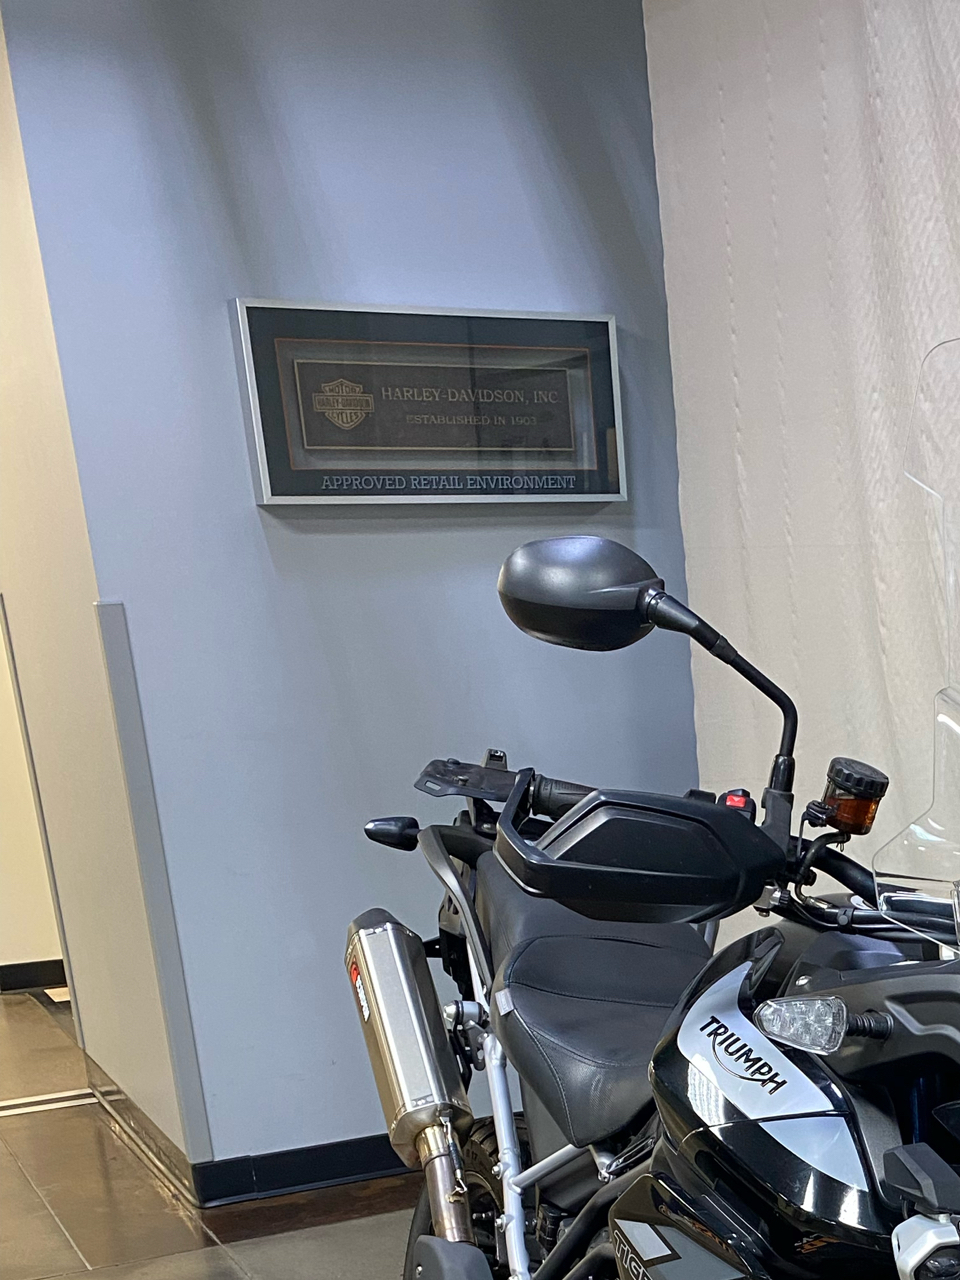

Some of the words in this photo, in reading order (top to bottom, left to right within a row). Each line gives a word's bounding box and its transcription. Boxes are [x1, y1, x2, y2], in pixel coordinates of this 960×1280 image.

[406, 414, 490, 426] ESTABLISHED
[494, 416, 506, 426] IN
[511, 416, 537, 427] 1903
[321, 475, 406, 490] APPROVED
[410, 475, 464, 490] RETAIL
[466, 475, 576, 490] ENVIRONMENT
[699, 1015, 788, 1096] TRIUMPH
